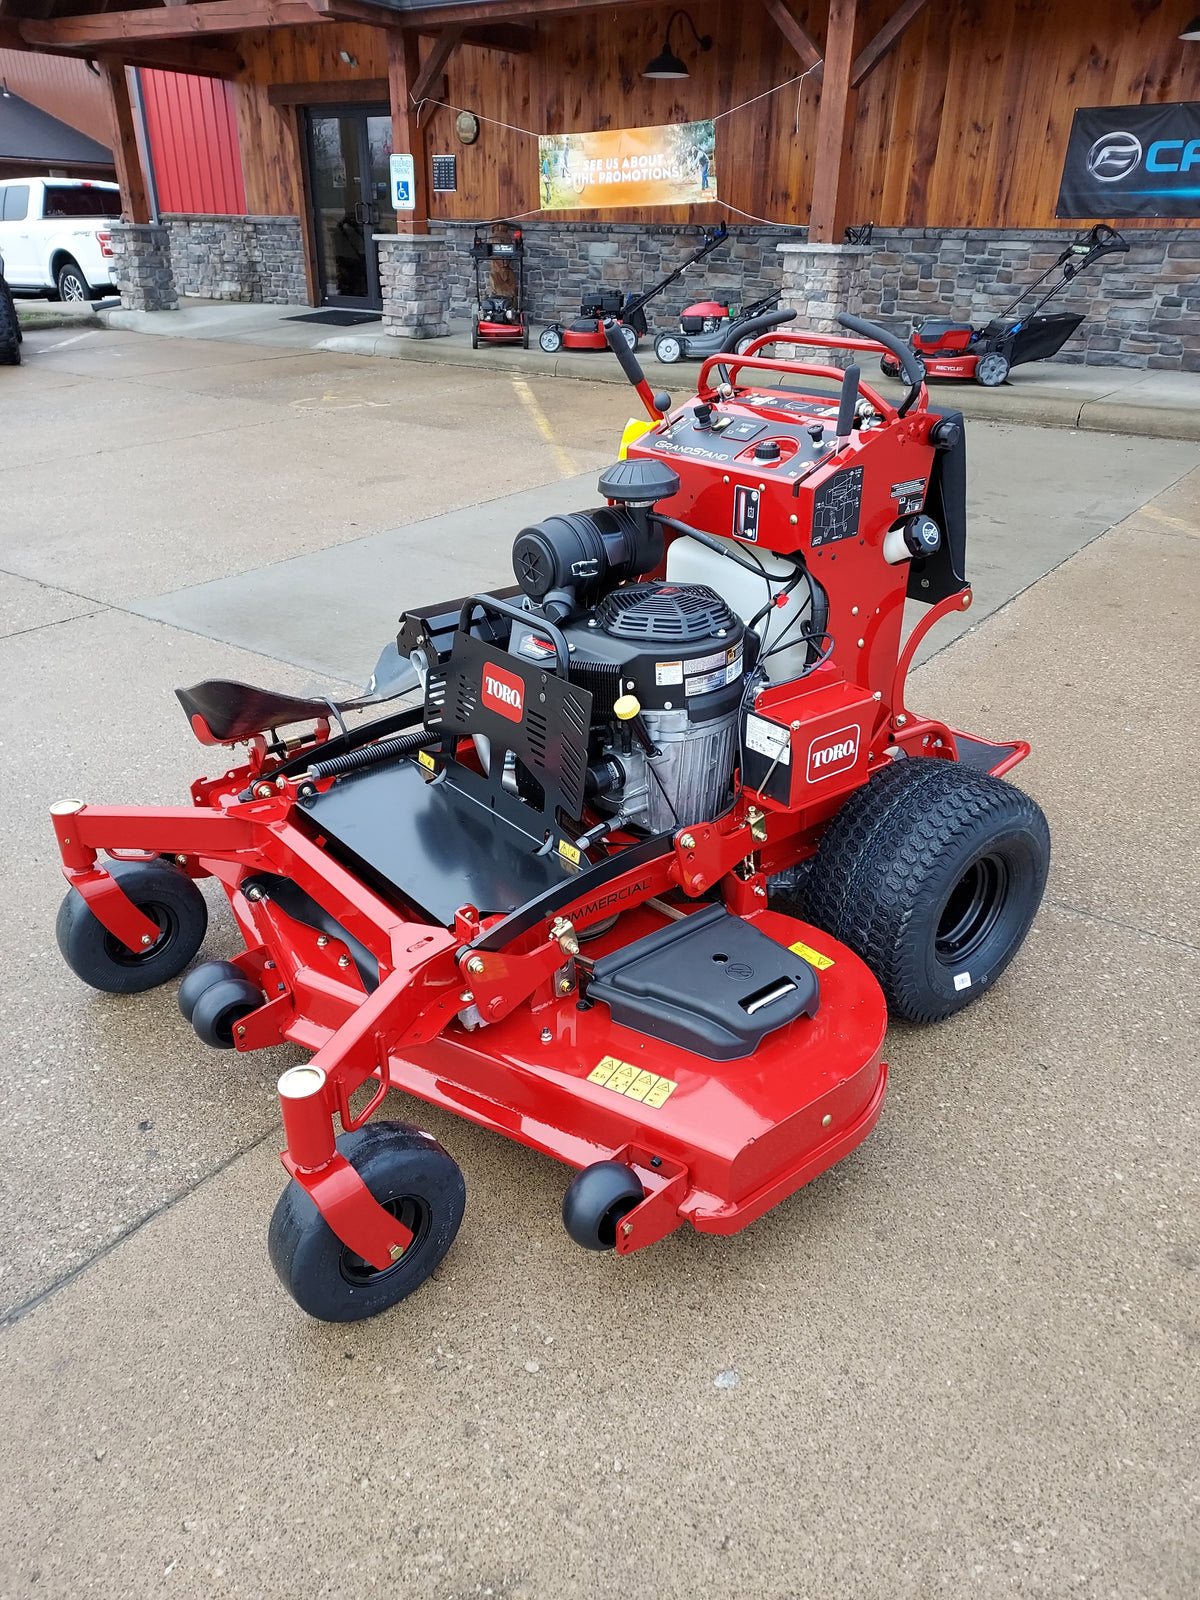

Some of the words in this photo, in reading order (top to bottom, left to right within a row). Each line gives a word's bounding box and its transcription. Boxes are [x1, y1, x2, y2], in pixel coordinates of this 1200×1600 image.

[582, 158, 603, 171] SEE
[605, 157, 619, 169] US
[622, 154, 664, 169] ABOUT
[565, 172, 595, 185] STIHL
[599, 166, 683, 184] PROMOTIONS!
[935, 364, 964, 372] RECYCLER
